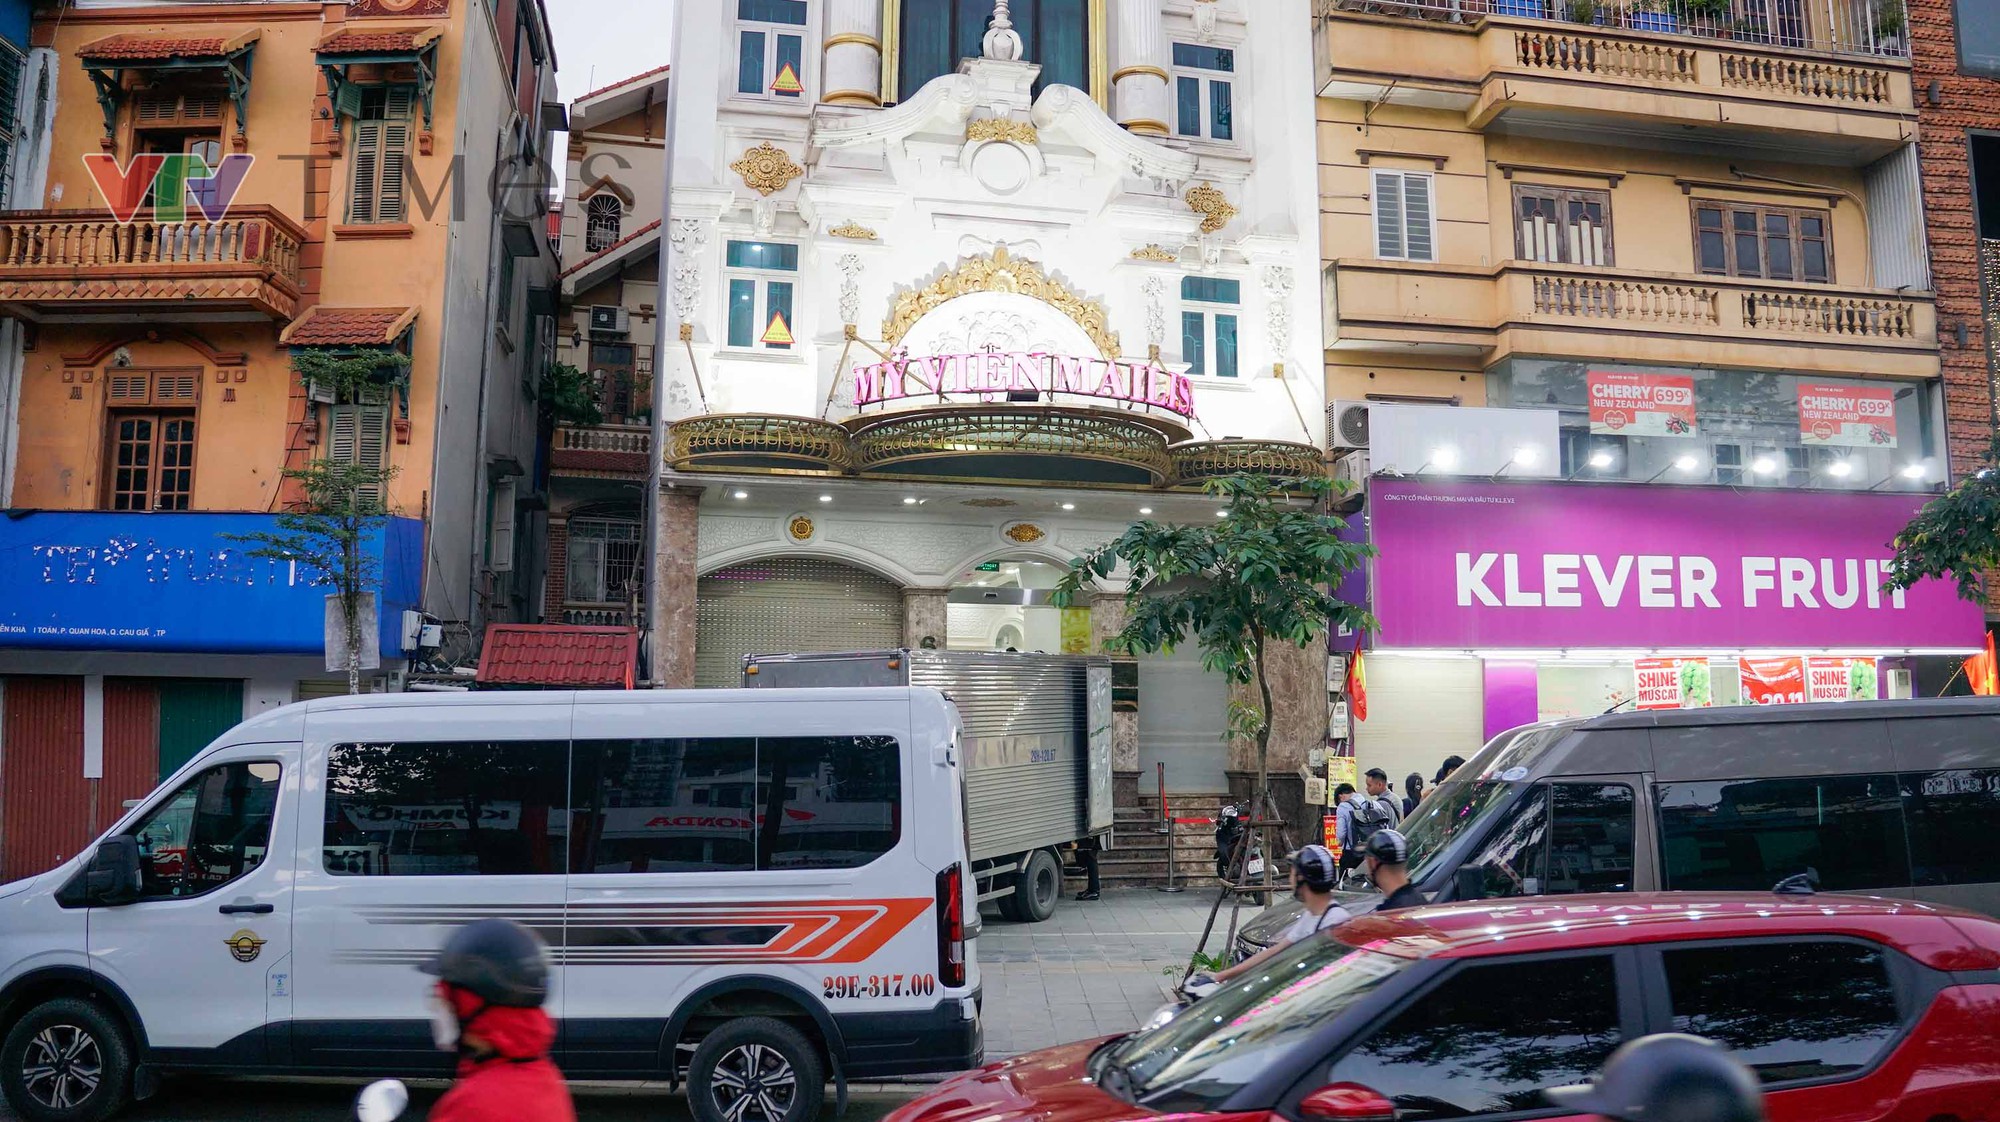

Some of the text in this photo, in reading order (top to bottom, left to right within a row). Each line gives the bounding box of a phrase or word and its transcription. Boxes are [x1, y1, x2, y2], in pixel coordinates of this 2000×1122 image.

[919, 343, 1050, 403] VIỆN
[1592, 383, 1651, 400] CHERRY
[1593, 399, 1655, 410] NEW ZEALAND
[1801, 395, 1855, 411] CHERRY
[1802, 410, 1859, 421] NEW ZEALAND
[1455, 552, 1909, 610] KLEVER FRUIT
[68, 627, 90, 636] QUAN
[1638, 671, 1677, 688] SHINE
[1812, 670, 1847, 686] SHINE
[1638, 688, 1678, 702] MUSCAT
[1812, 687, 1848, 699] MUSCAT
[823, 973, 935, 999] 29E-317.00
